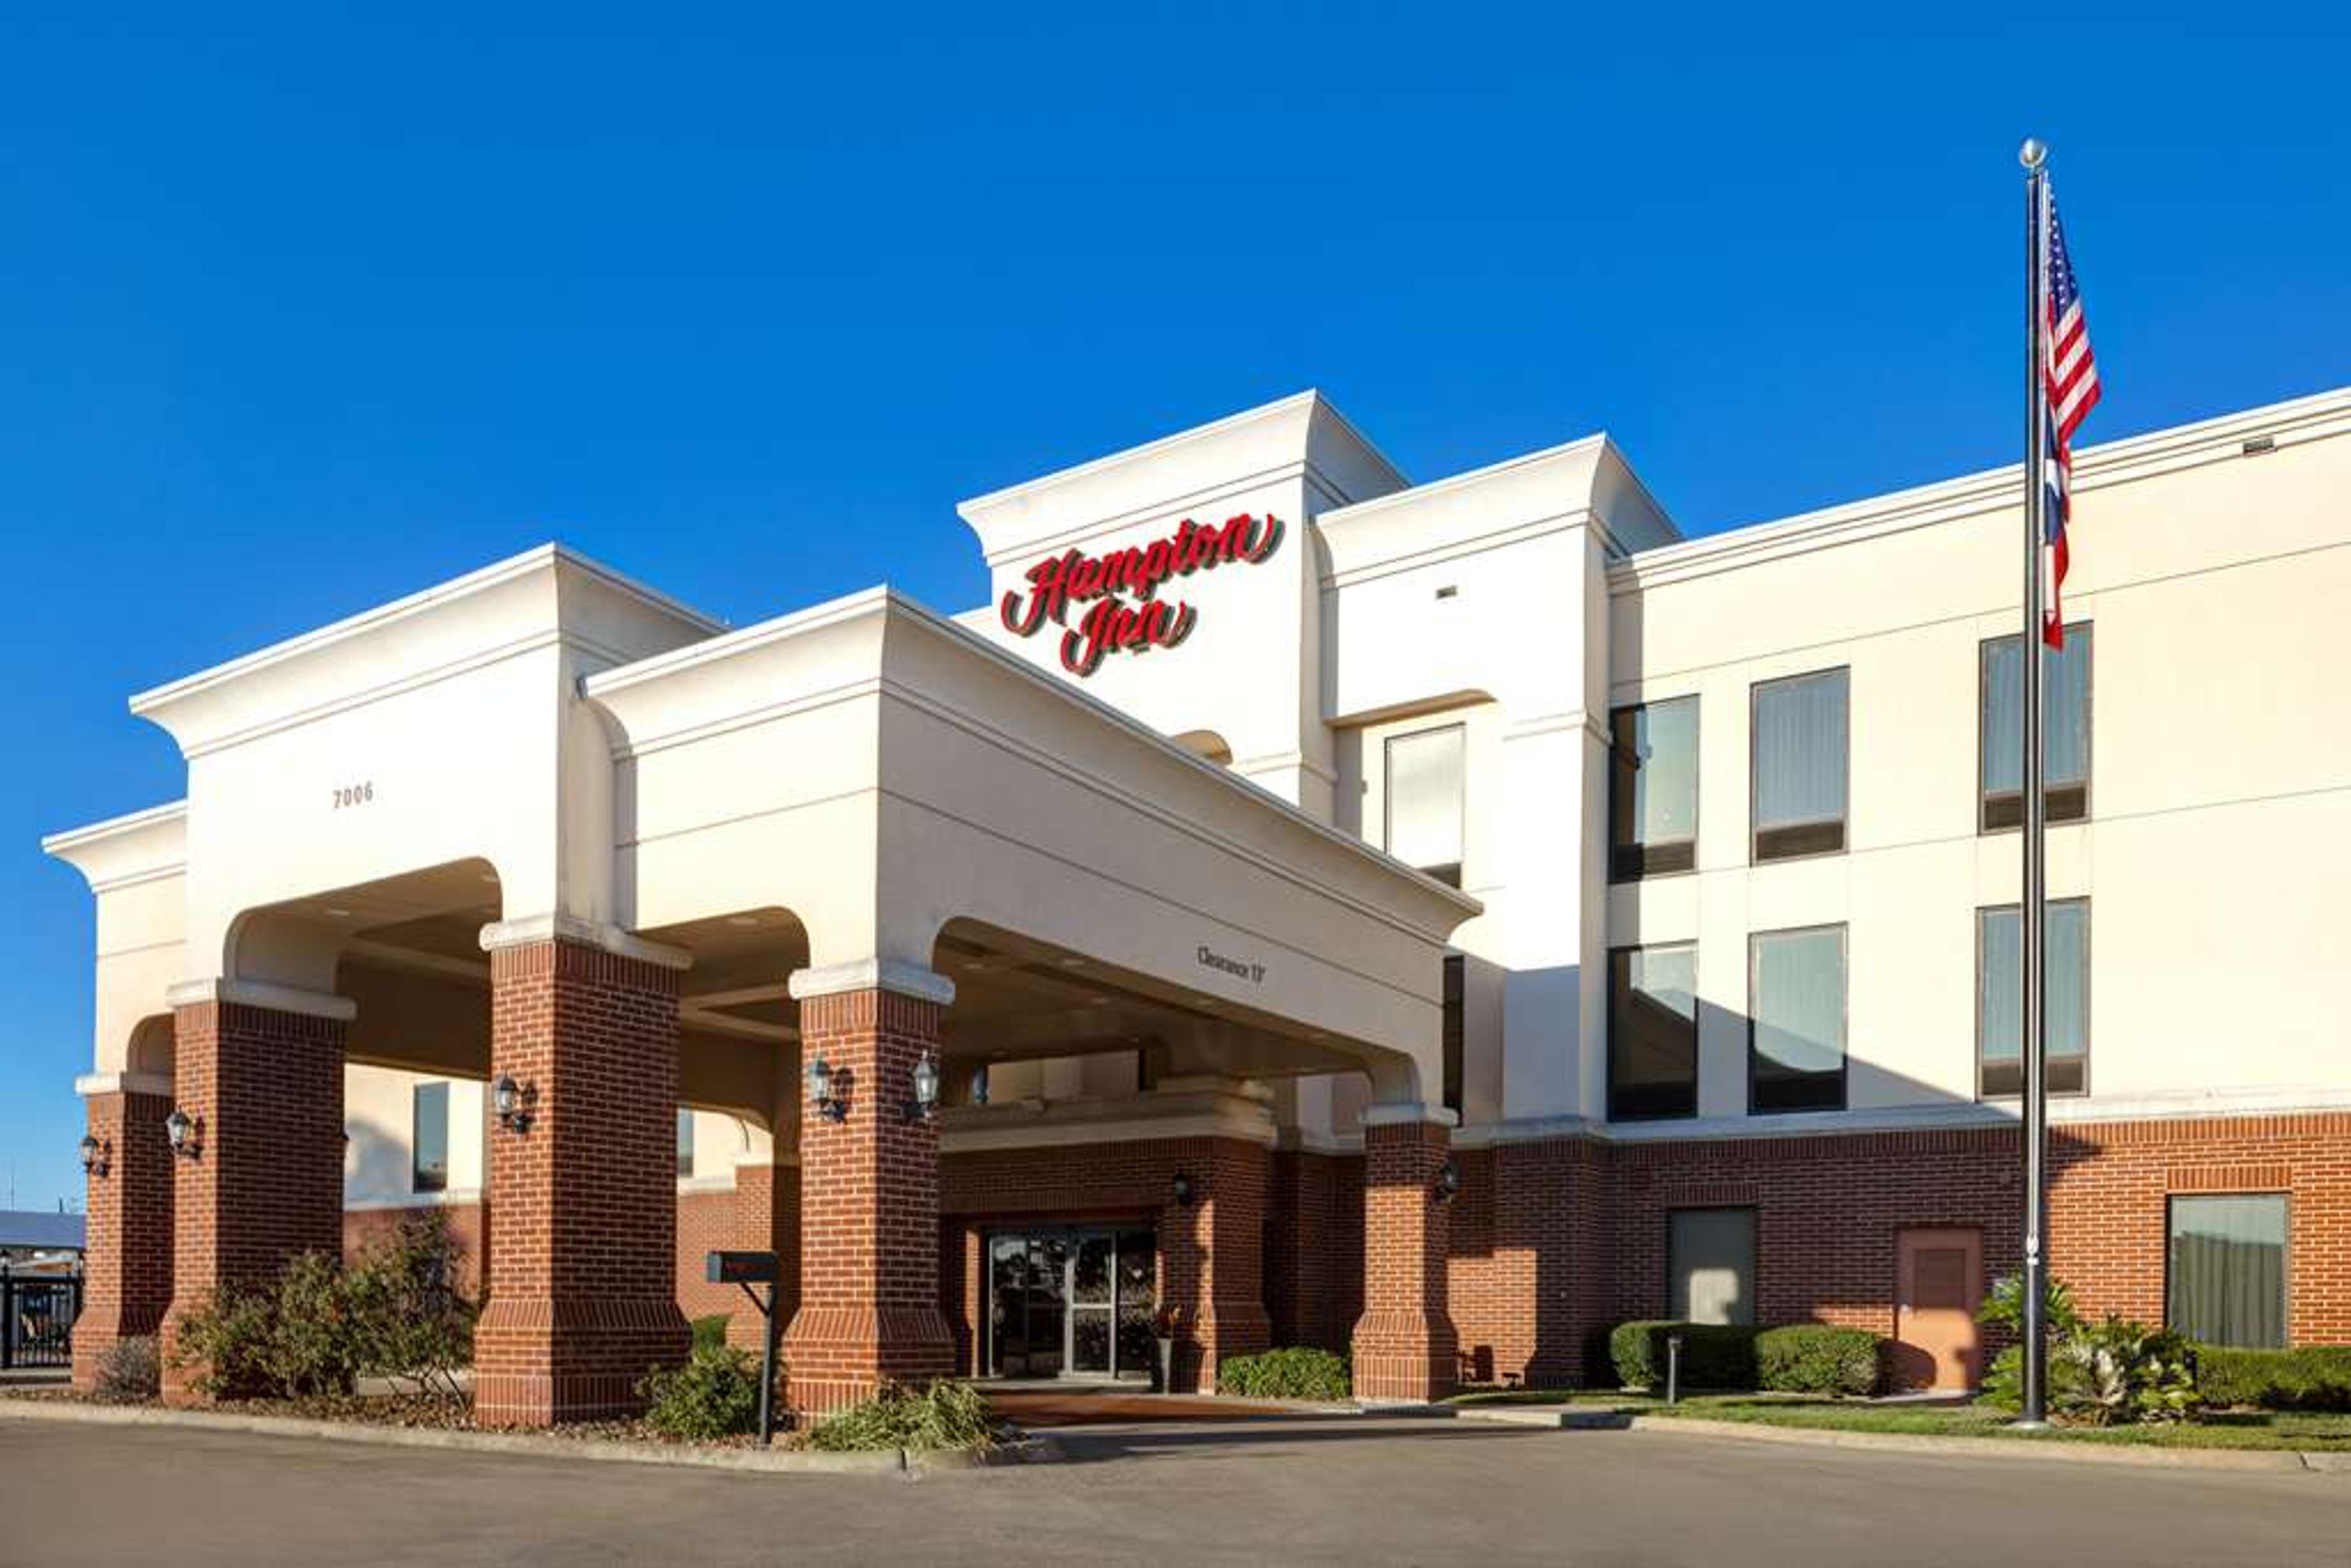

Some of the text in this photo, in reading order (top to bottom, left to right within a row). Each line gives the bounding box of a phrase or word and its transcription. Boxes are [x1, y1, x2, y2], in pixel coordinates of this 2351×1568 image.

[1000, 513, 1286, 638] Hampton
[1060, 595, 1198, 677] Inn
[332, 780, 373, 809] 7006
